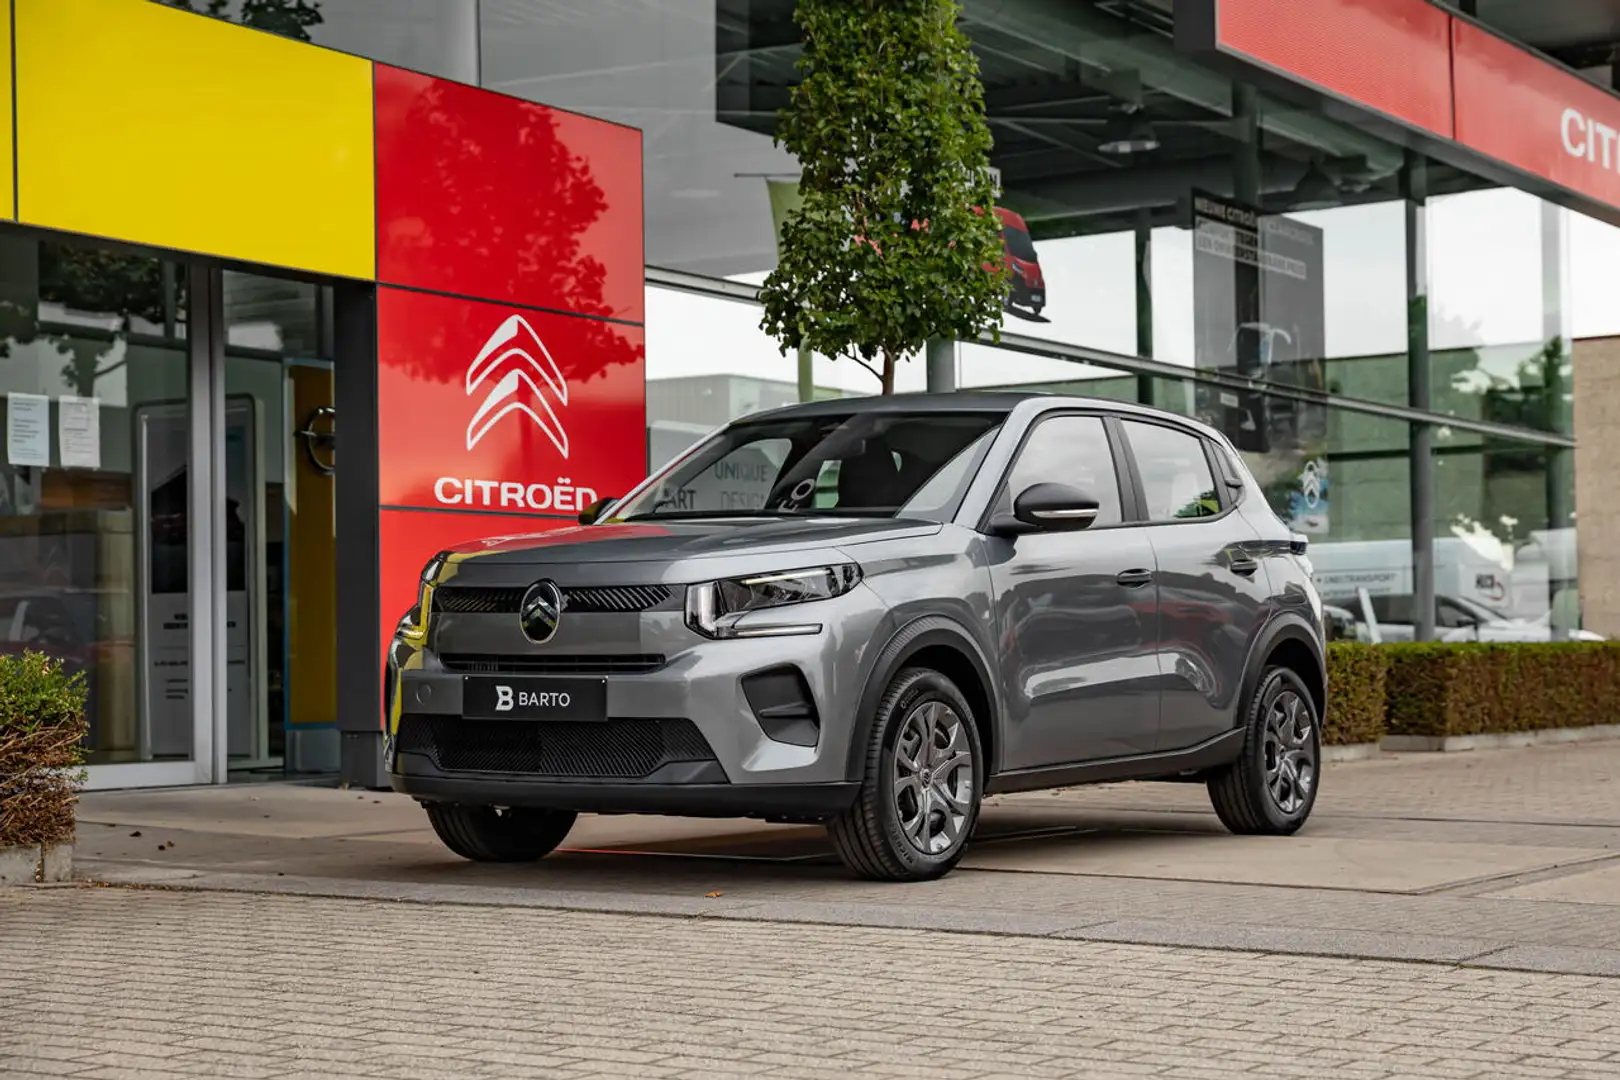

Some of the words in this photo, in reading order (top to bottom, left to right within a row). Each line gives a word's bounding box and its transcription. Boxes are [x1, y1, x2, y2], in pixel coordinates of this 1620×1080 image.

[1561, 107, 1620, 175] CIT
[715, 461, 769, 483] UNIQUE
[434, 476, 598, 511] CITROËN
[518, 691, 571, 707] BARTO
